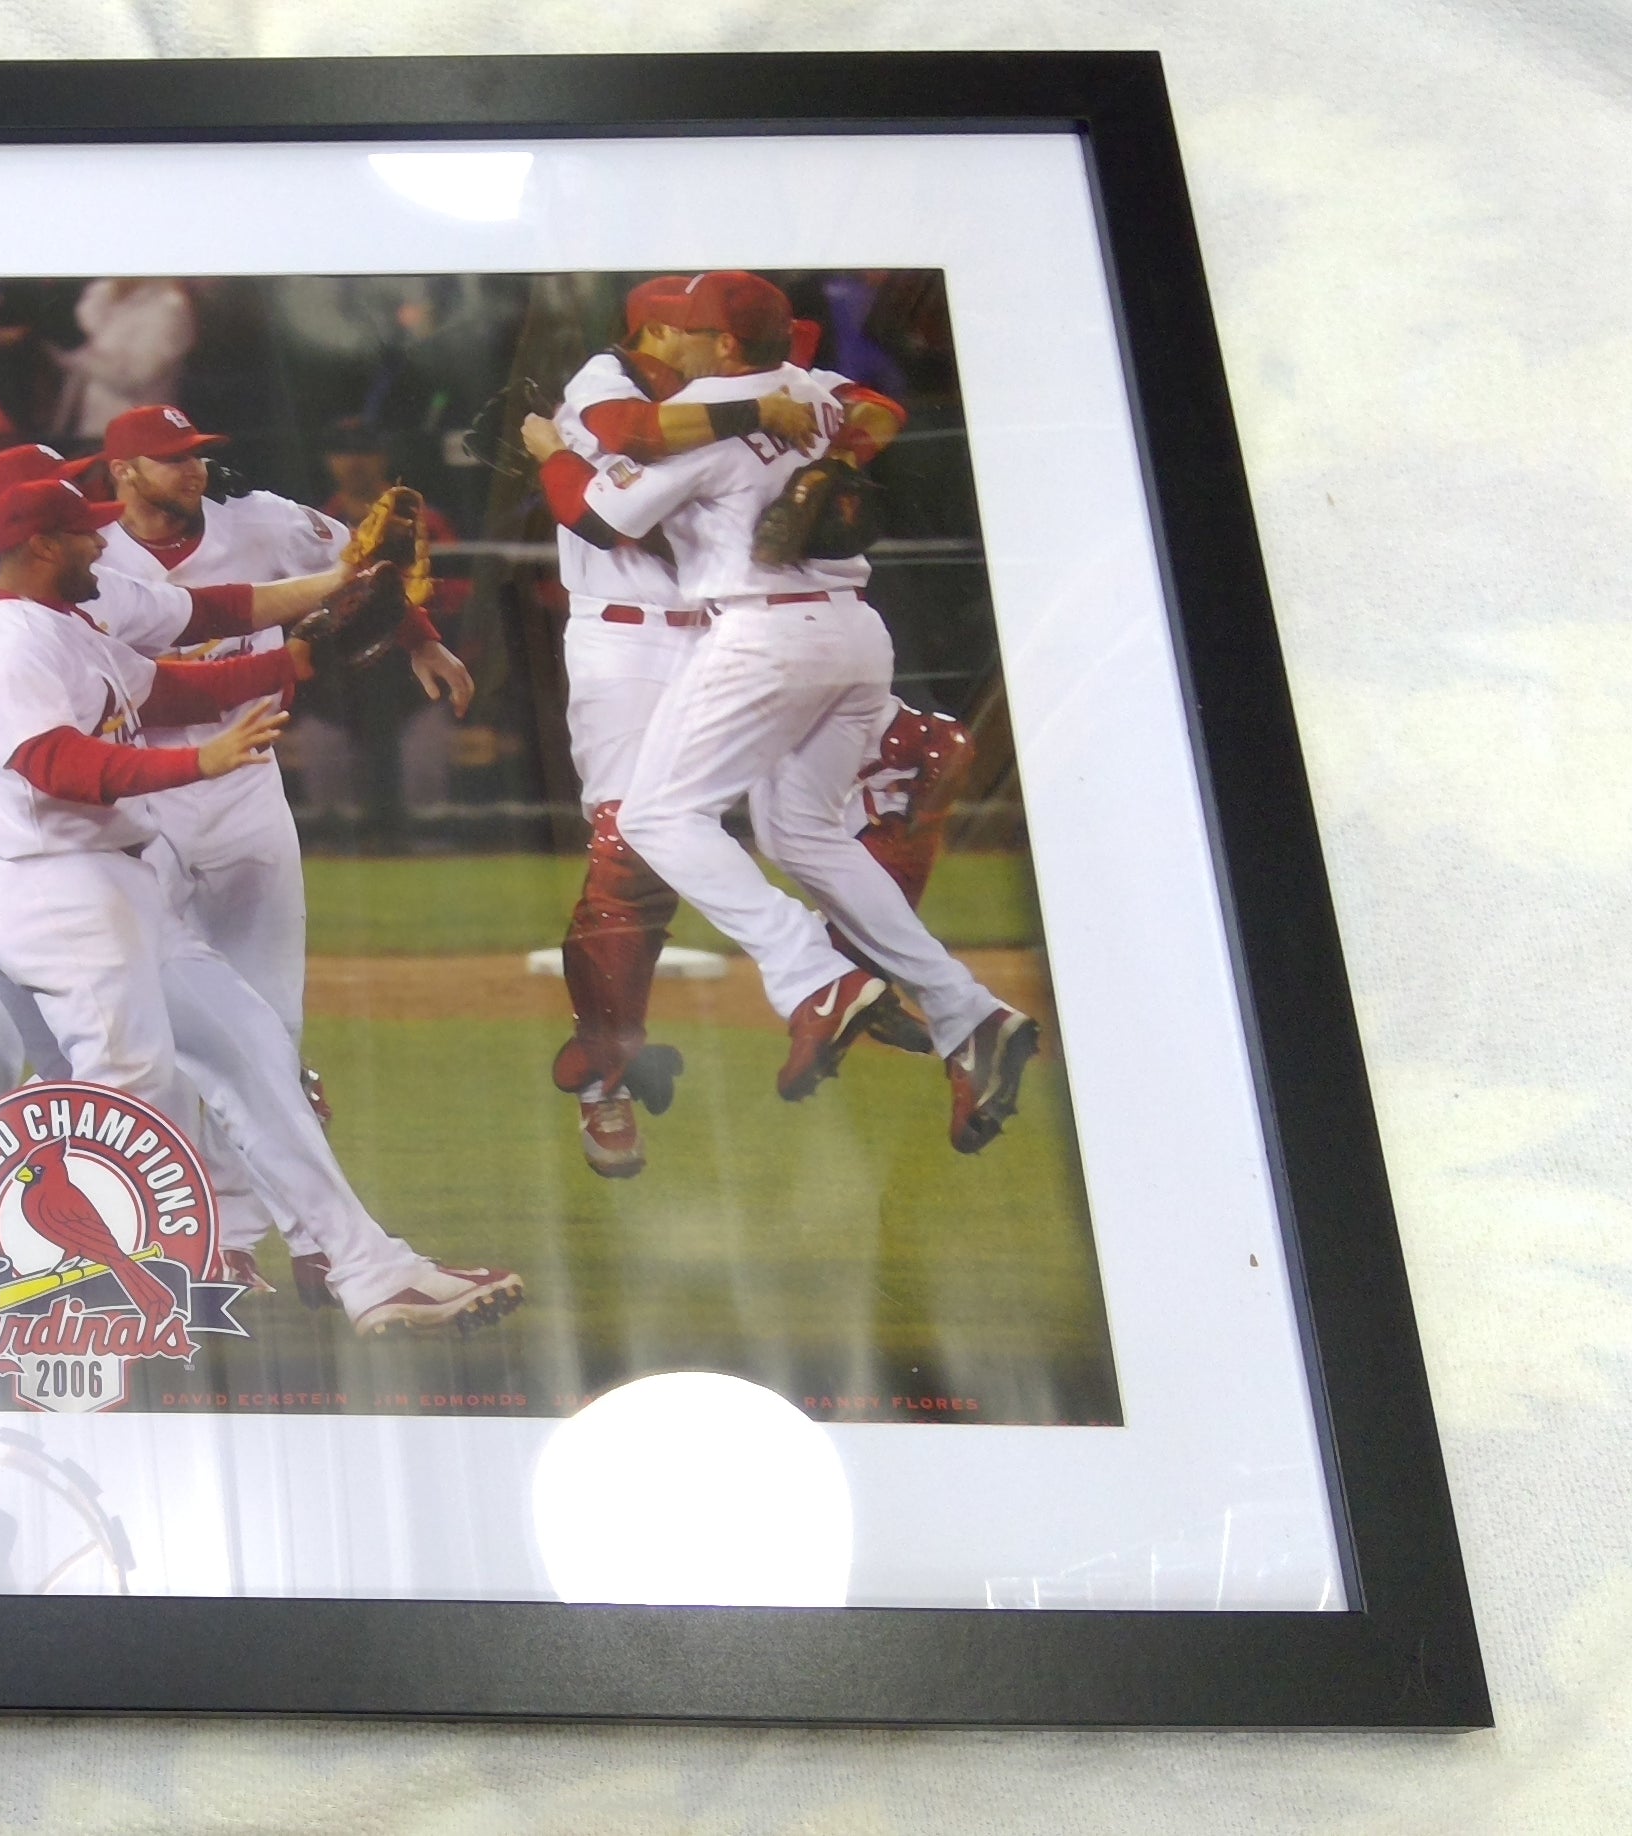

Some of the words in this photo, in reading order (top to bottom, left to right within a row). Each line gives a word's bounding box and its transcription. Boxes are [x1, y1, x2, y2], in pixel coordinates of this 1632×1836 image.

[21, 1099, 199, 1237] CHAMPIONS
[36, 1359, 104, 1398] 2006
[162, 1393, 229, 1407] DAVID
[238, 1393, 348, 1407] ECKSTEIN
[420, 1394, 528, 1408] EDMONDS
[891, 1396, 979, 1411] FLORES
